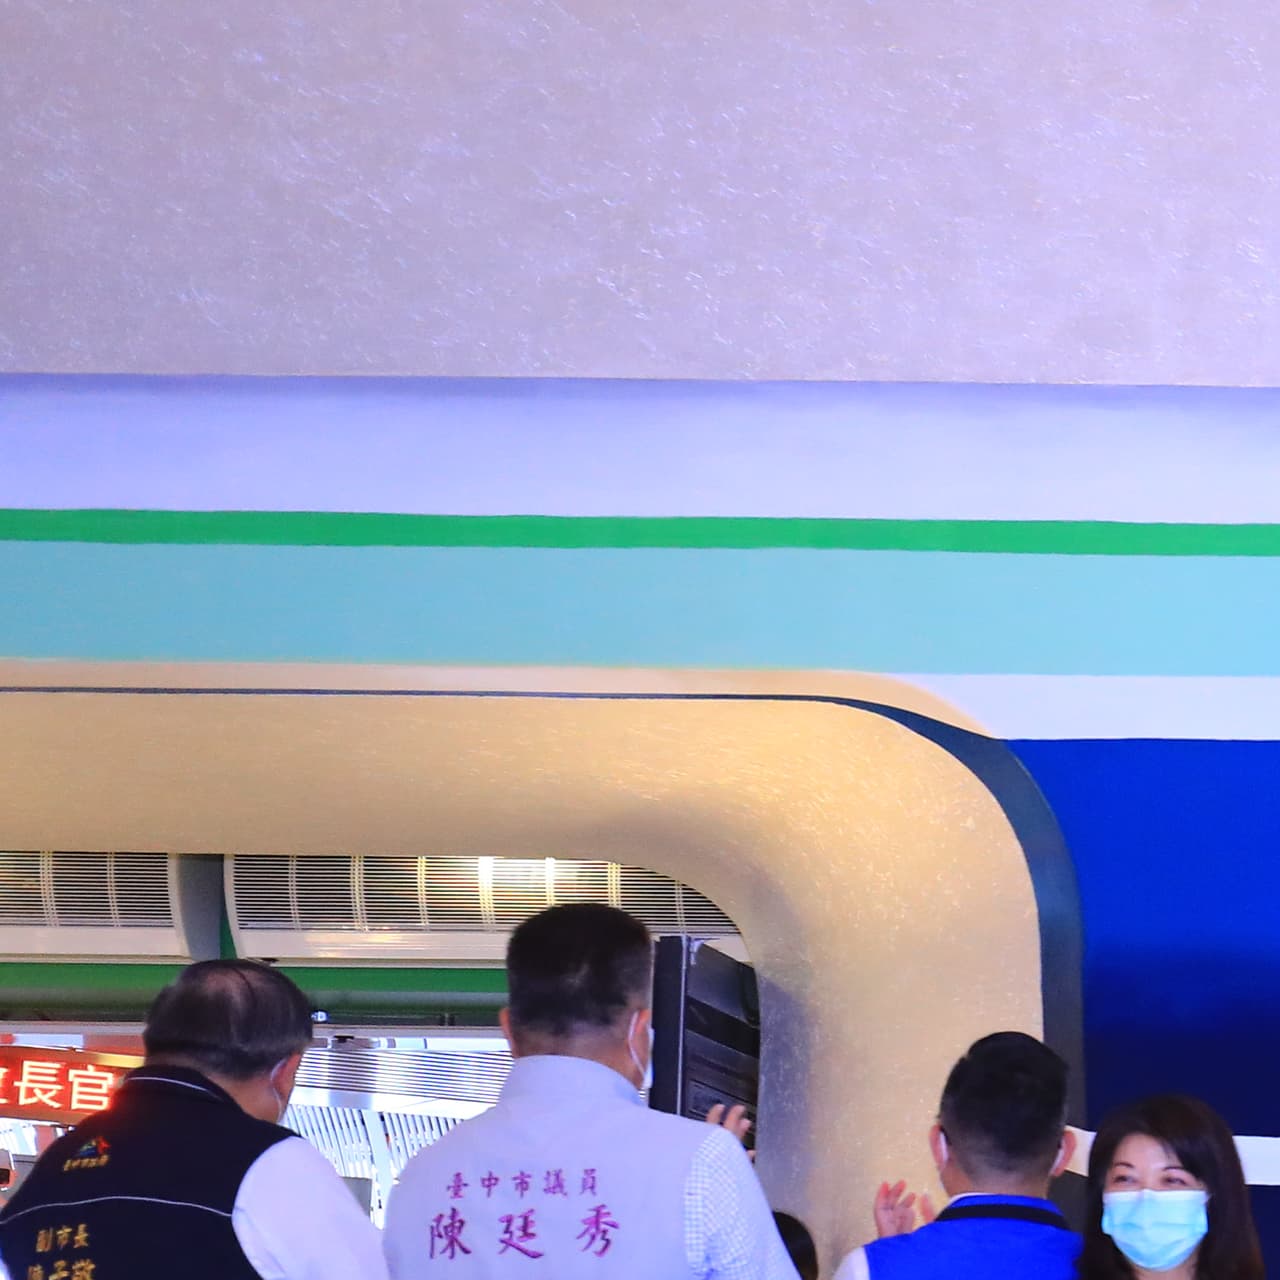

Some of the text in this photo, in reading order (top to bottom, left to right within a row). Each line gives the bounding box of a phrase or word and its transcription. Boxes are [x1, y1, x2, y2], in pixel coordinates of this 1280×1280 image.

[0, 1060, 114, 1110] 長官
[446, 1168, 597, 1199] 臺中市議員
[429, 1204, 620, 1260] 陳廷秀
